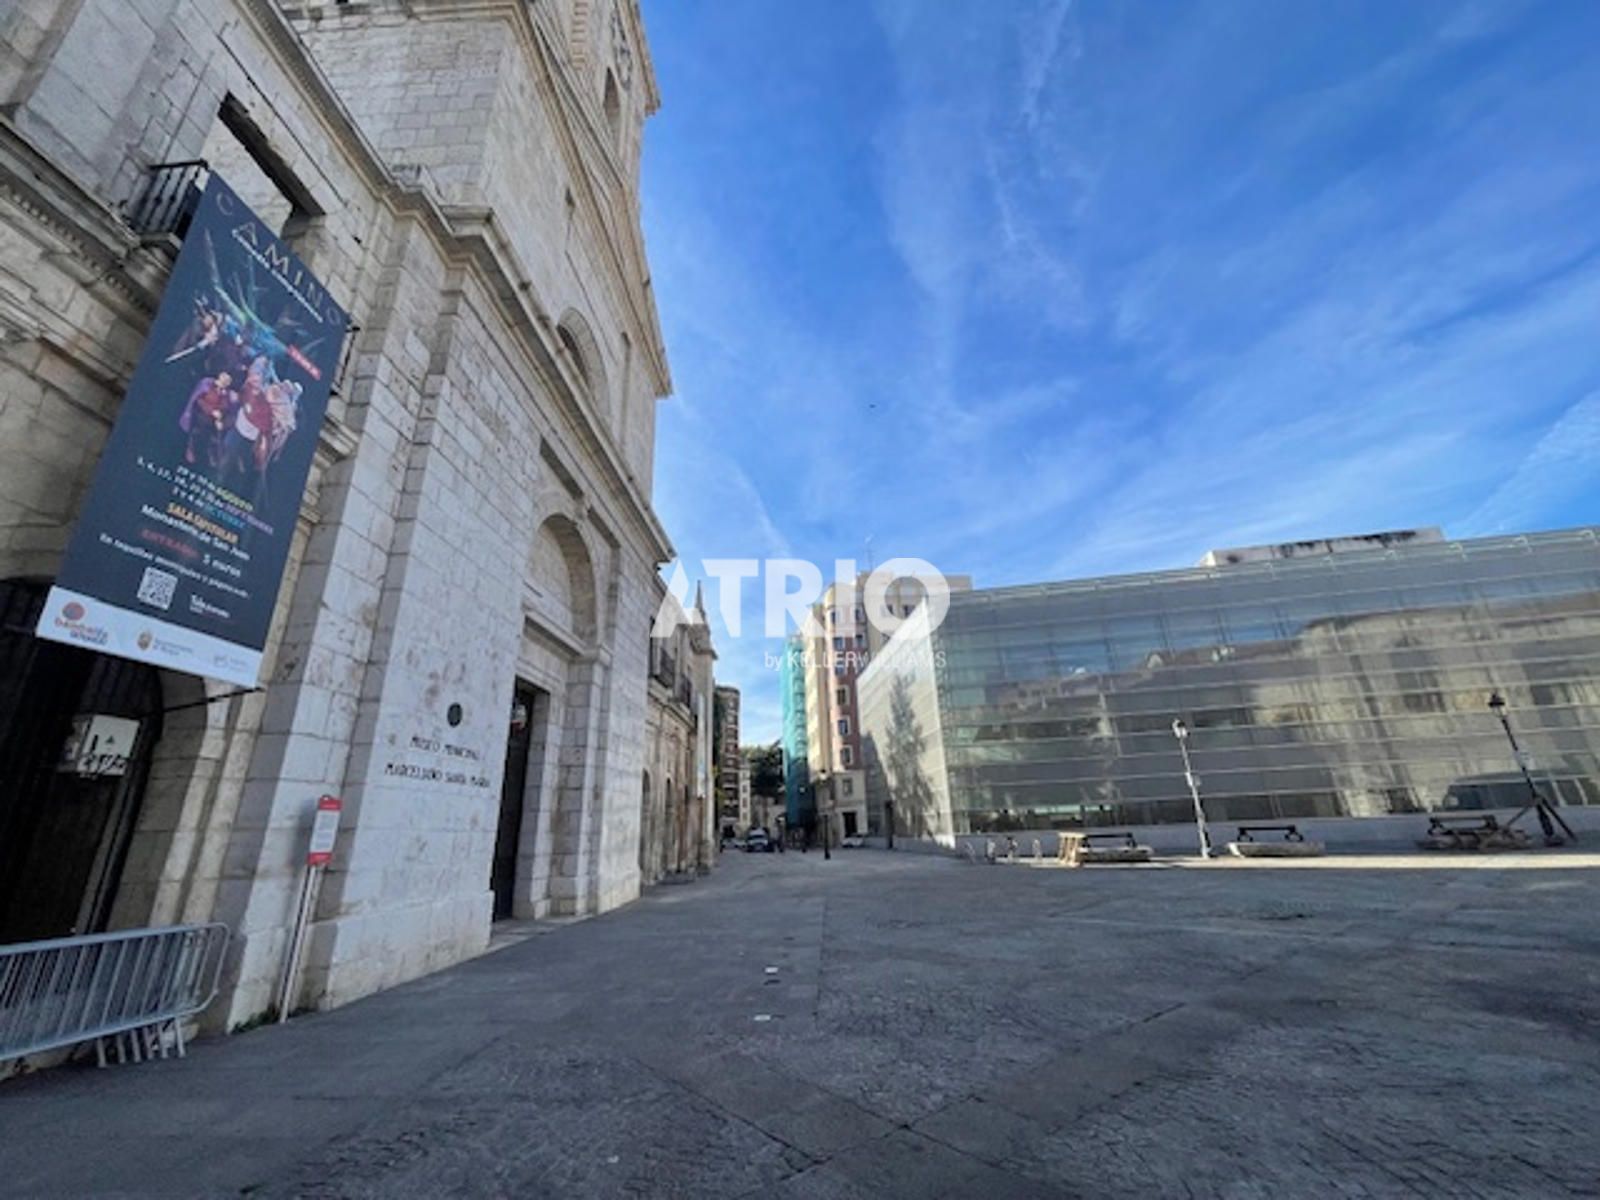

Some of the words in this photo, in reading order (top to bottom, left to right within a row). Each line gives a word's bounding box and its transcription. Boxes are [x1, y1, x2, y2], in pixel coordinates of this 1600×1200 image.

[216, 192, 341, 325] CAMINO
[141, 503, 199, 536] Monasterio
[167, 501, 194, 521] SALA
